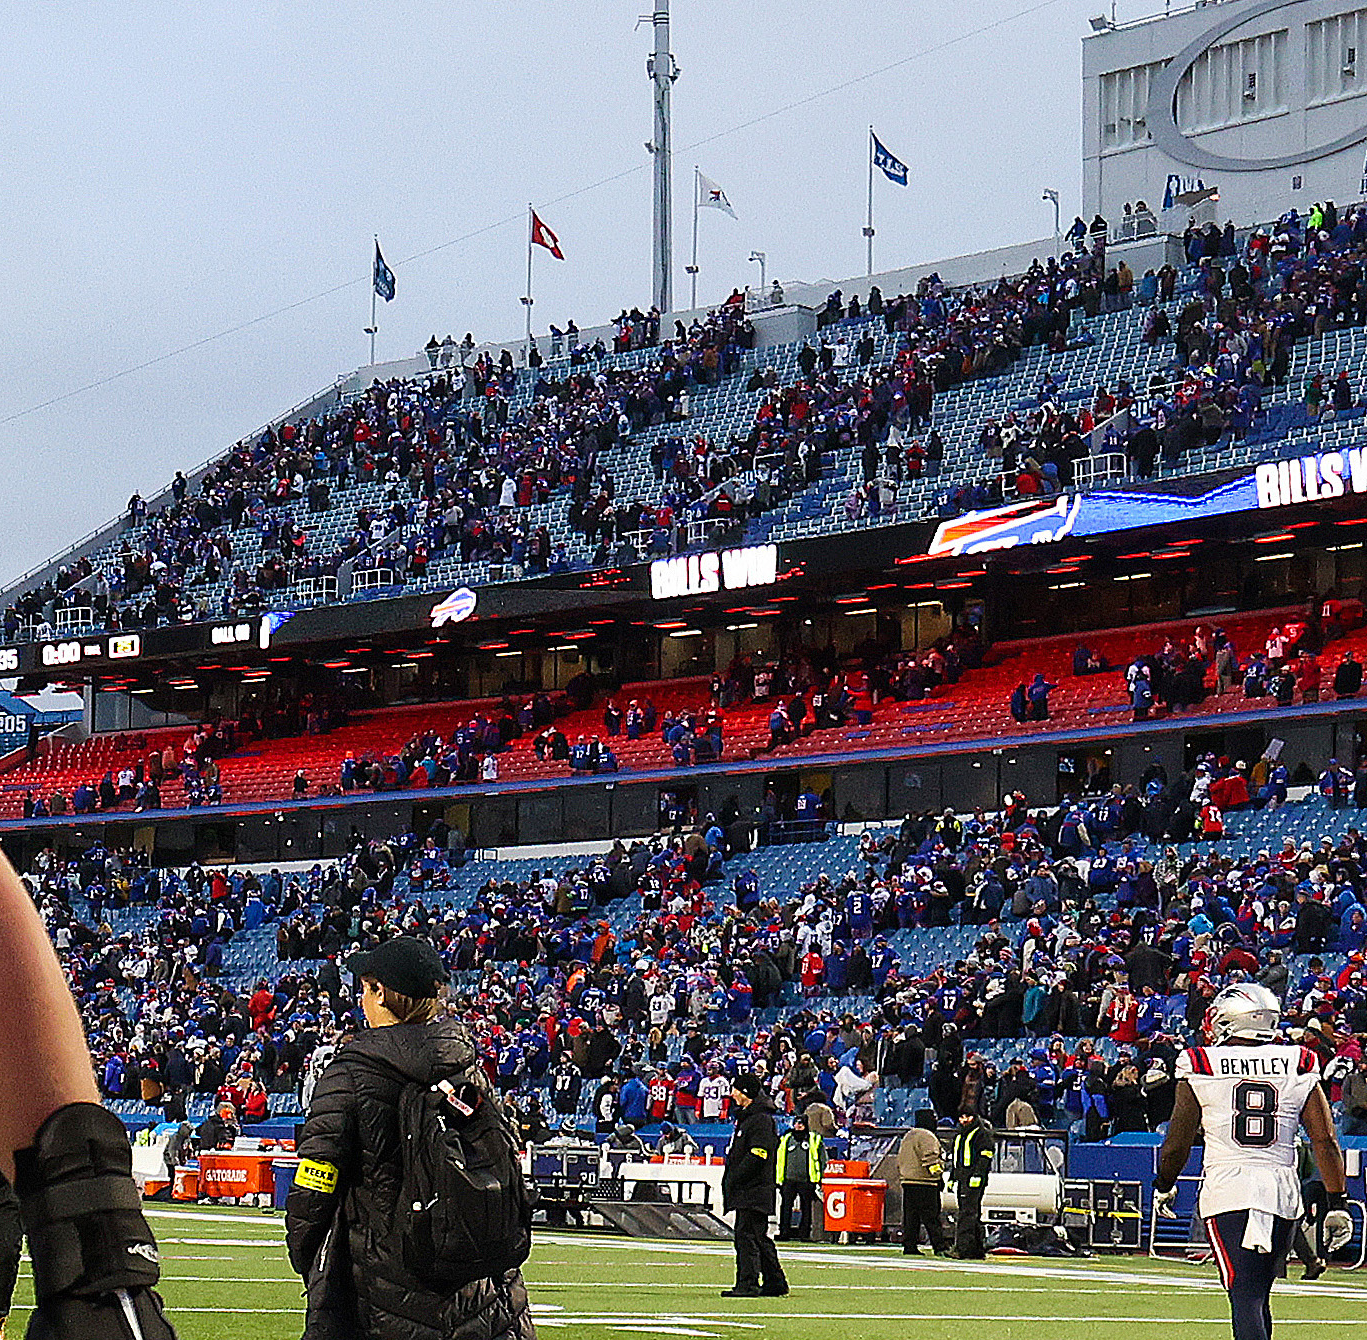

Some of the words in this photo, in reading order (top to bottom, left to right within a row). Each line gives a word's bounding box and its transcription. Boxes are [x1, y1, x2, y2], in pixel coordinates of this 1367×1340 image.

[1255, 455, 1344, 508] BILLS
[651, 550, 719, 599] BILLS
[722, 543, 778, 590] WIN
[43, 642, 80, 665] 0:00
[871, 954, 883, 969] 17
[943, 995, 956, 1010] 17
[1220, 1056, 1290, 1076] BENTLEY
[1229, 1077, 1281, 1147] 8
[206, 1170, 247, 1182] GATORADE
[304, 1165, 328, 1180] WEEK
[826, 1190, 847, 1219] G
